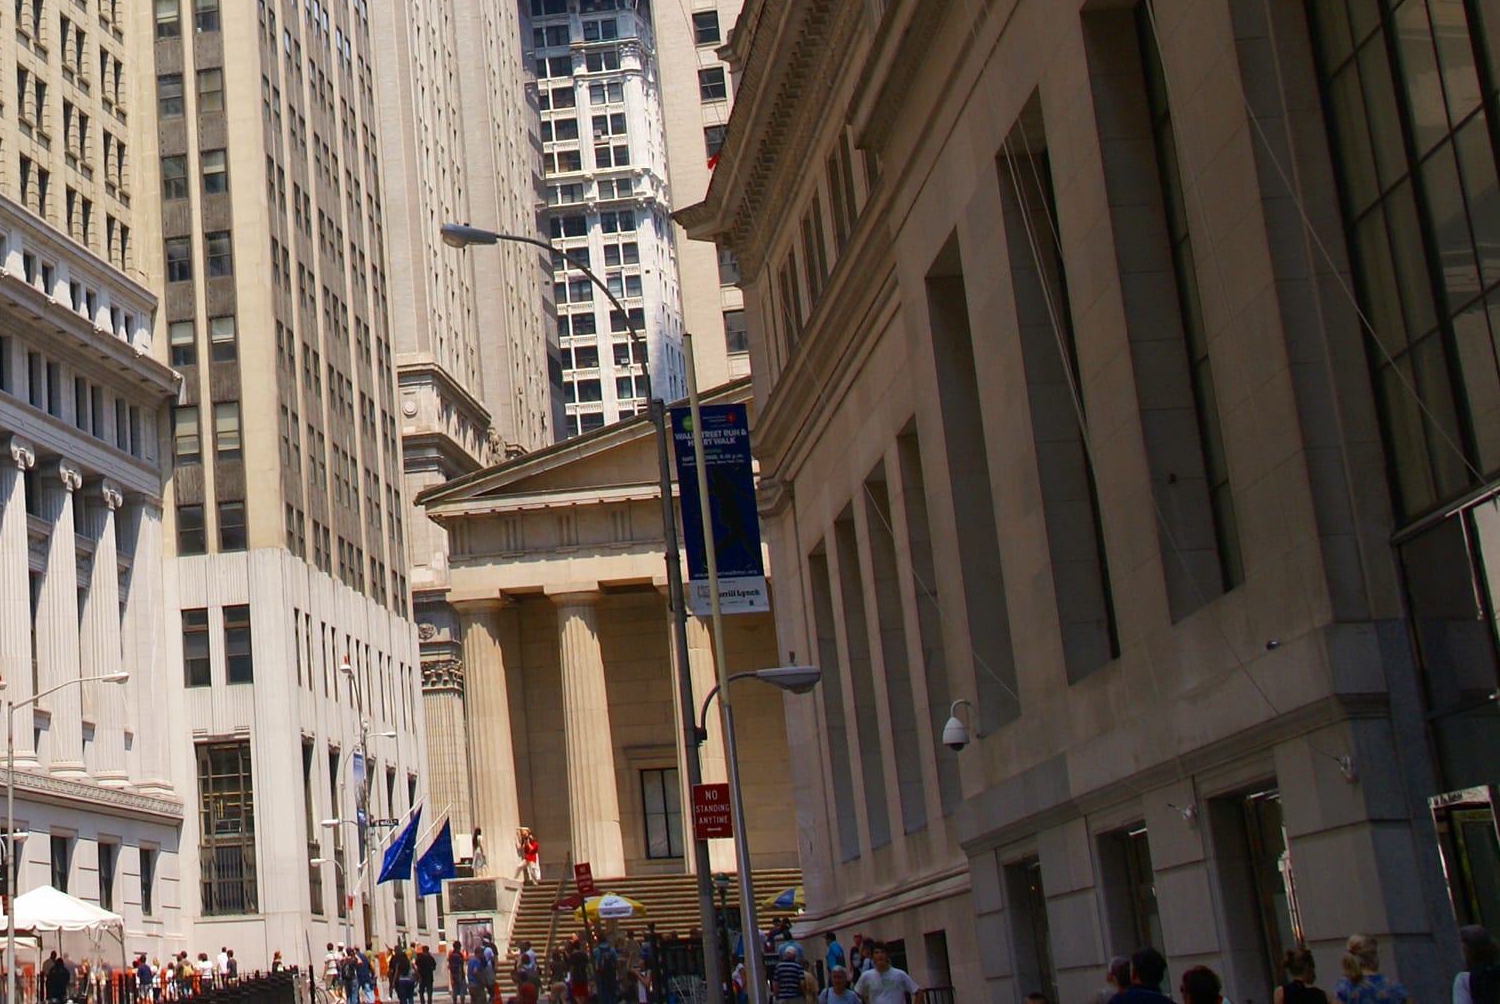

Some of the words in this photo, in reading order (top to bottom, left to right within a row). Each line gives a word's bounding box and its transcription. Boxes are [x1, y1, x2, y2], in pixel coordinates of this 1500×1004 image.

[701, 430, 722, 438] TREET
[688, 438, 713, 446] HRT
[713, 437, 736, 445] WALK
[704, 789, 718, 801] NO
[695, 803, 730, 814] STANDING
[699, 815, 729, 825] ANYTIME
